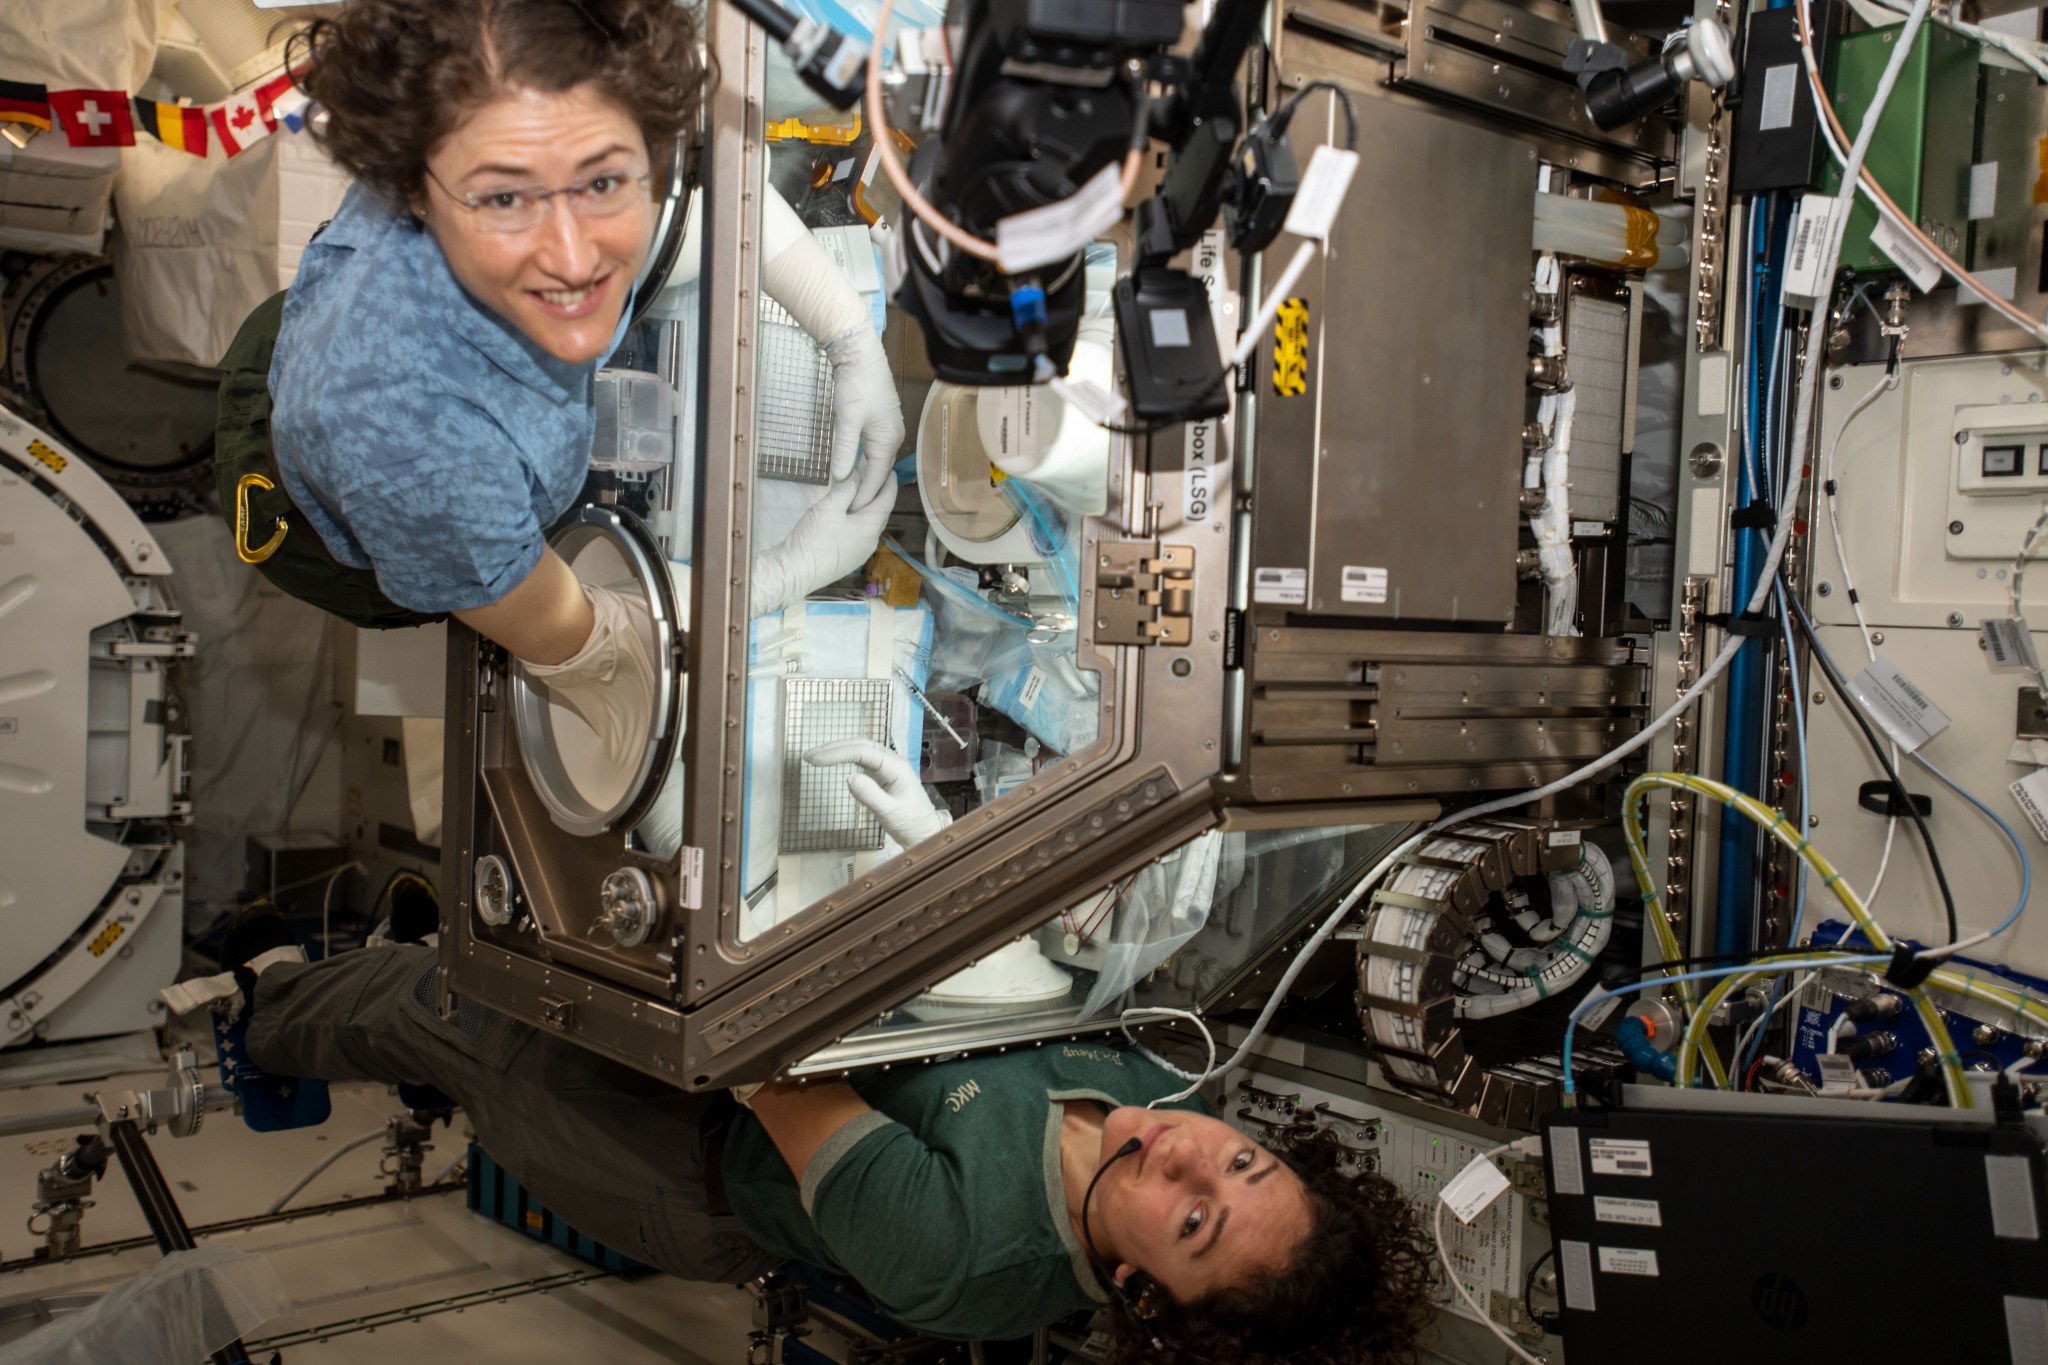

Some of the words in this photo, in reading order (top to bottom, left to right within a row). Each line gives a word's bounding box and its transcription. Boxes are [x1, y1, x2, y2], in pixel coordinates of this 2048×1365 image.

[1201, 231, 1218, 268] Life
[1186, 465, 1208, 522] (LSG)
[239, 506, 247, 532] CAMP
[1227, 611, 1236, 666] ILLUMINATION
[944, 1078, 982, 1113] MKC
[1597, 1198, 1629, 1208] FIRMWARE
[1630, 1201, 1656, 1210] VERSION
[1505, 1220, 1513, 1235] AND
[1504, 1236, 1512, 1274] MONITORING
